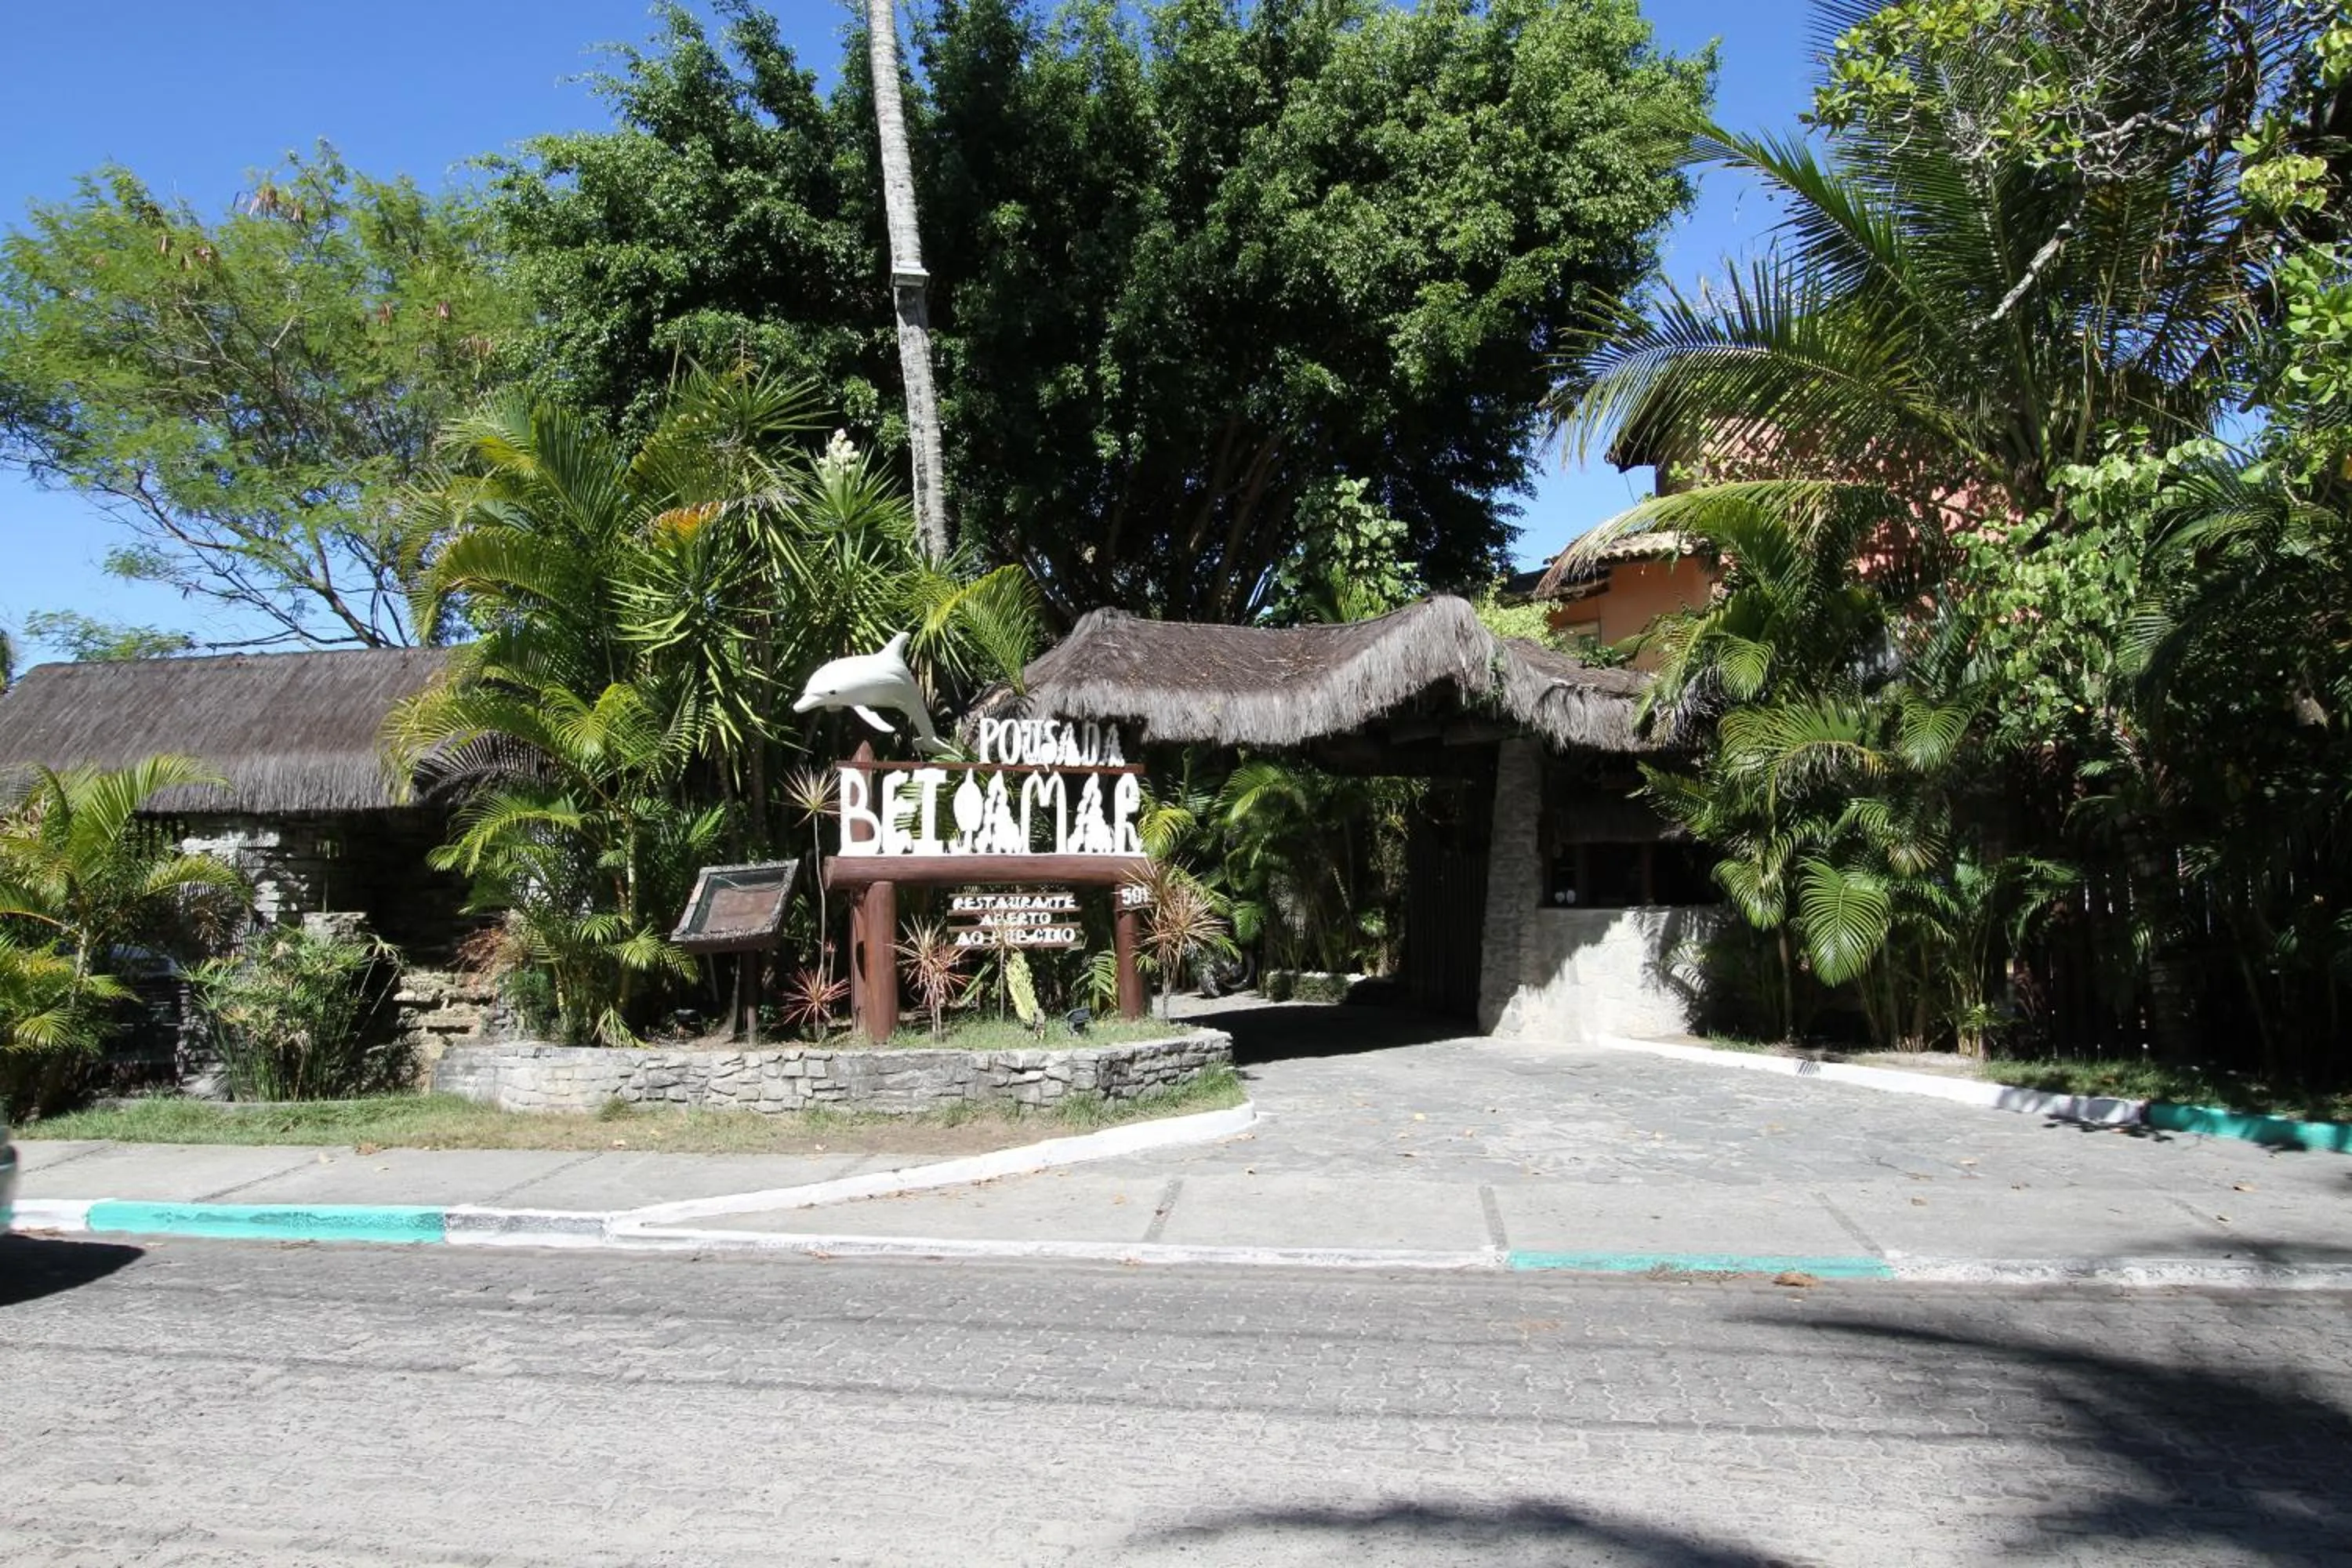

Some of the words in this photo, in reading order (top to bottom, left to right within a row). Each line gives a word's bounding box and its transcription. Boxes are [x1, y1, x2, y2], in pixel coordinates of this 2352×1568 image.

[978, 717, 1126, 771] POUSADA
[953, 895, 1076, 909] RESTAURANTE
[980, 912, 1051, 926] ABERTO
[955, 931, 984, 946] AO
